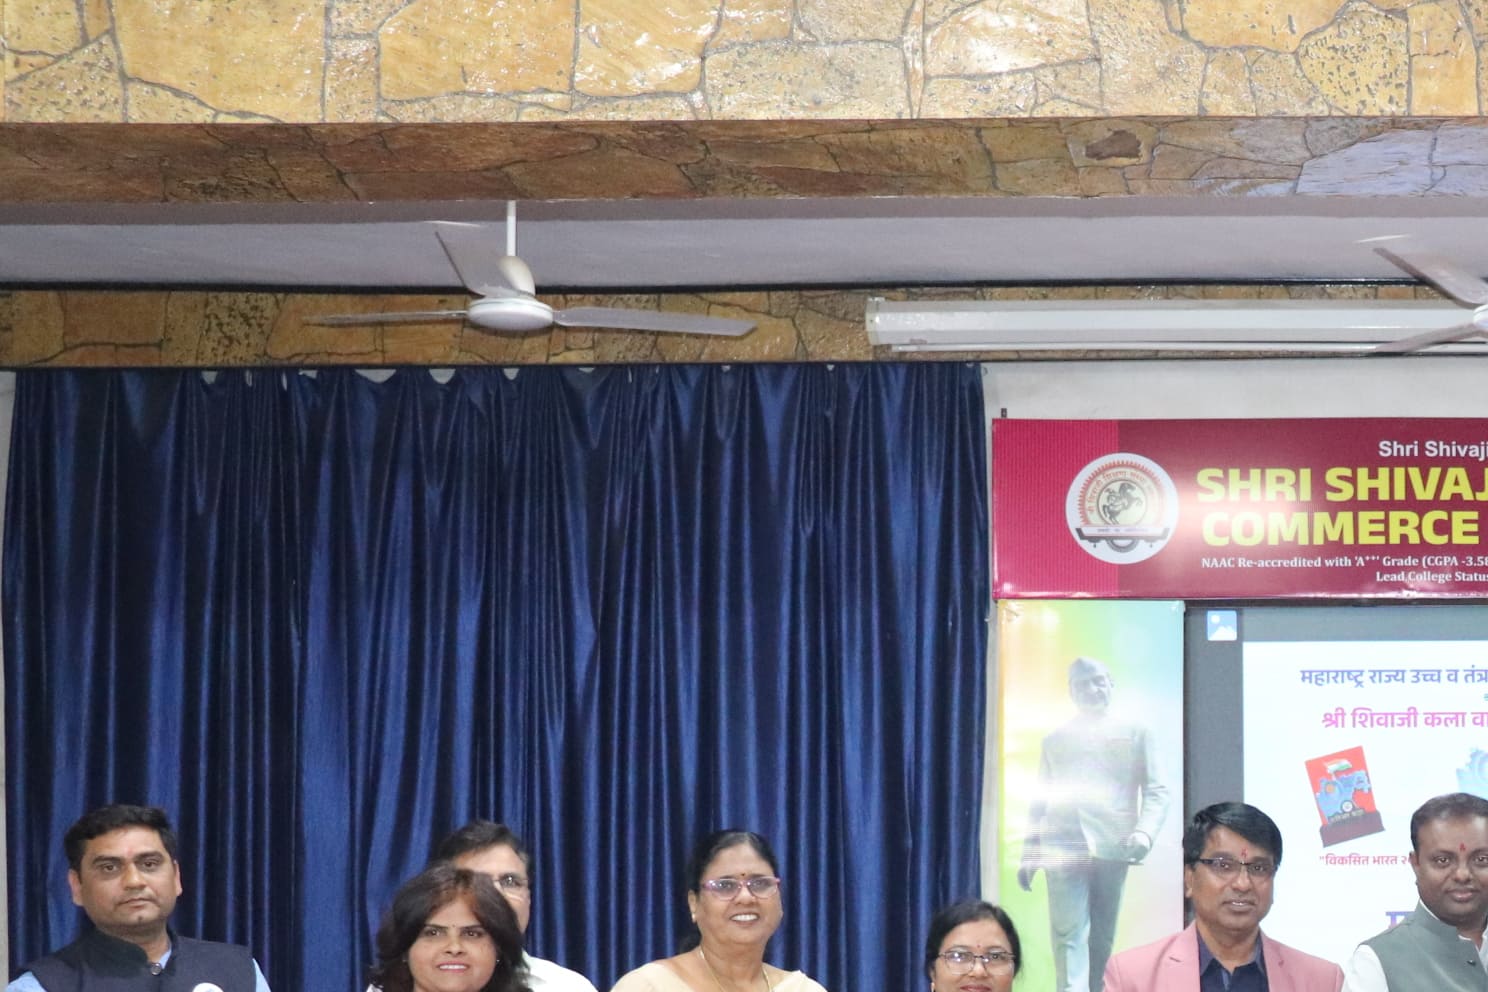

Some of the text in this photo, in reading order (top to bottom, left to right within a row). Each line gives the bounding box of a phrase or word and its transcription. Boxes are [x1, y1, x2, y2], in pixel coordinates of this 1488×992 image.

[1378, 440, 1419, 458] Shri
[1196, 467, 1314, 502] SHRI
[1202, 510, 1480, 546] COMMERCE
[1201, 557, 1235, 569] NAAC
[1237, 557, 1322, 569] Re-accredited
[1325, 556, 1352, 567] with
[1382, 556, 1419, 568] Grade
[1422, 556, 1459, 569] (CGPA
[1407, 570, 1452, 584] College
[1300, 669, 1365, 688] महाराष्ट्र
[1368, 669, 1407, 684] राज्य
[1409, 669, 1443, 684] उच्च
[1446, 669, 1460, 684] व
[1321, 706, 1347, 728] श्री
[1351, 706, 1419, 728] शिवाजी
[1423, 711, 1467, 728] कला
[1372, 854, 1398, 866] भारत
